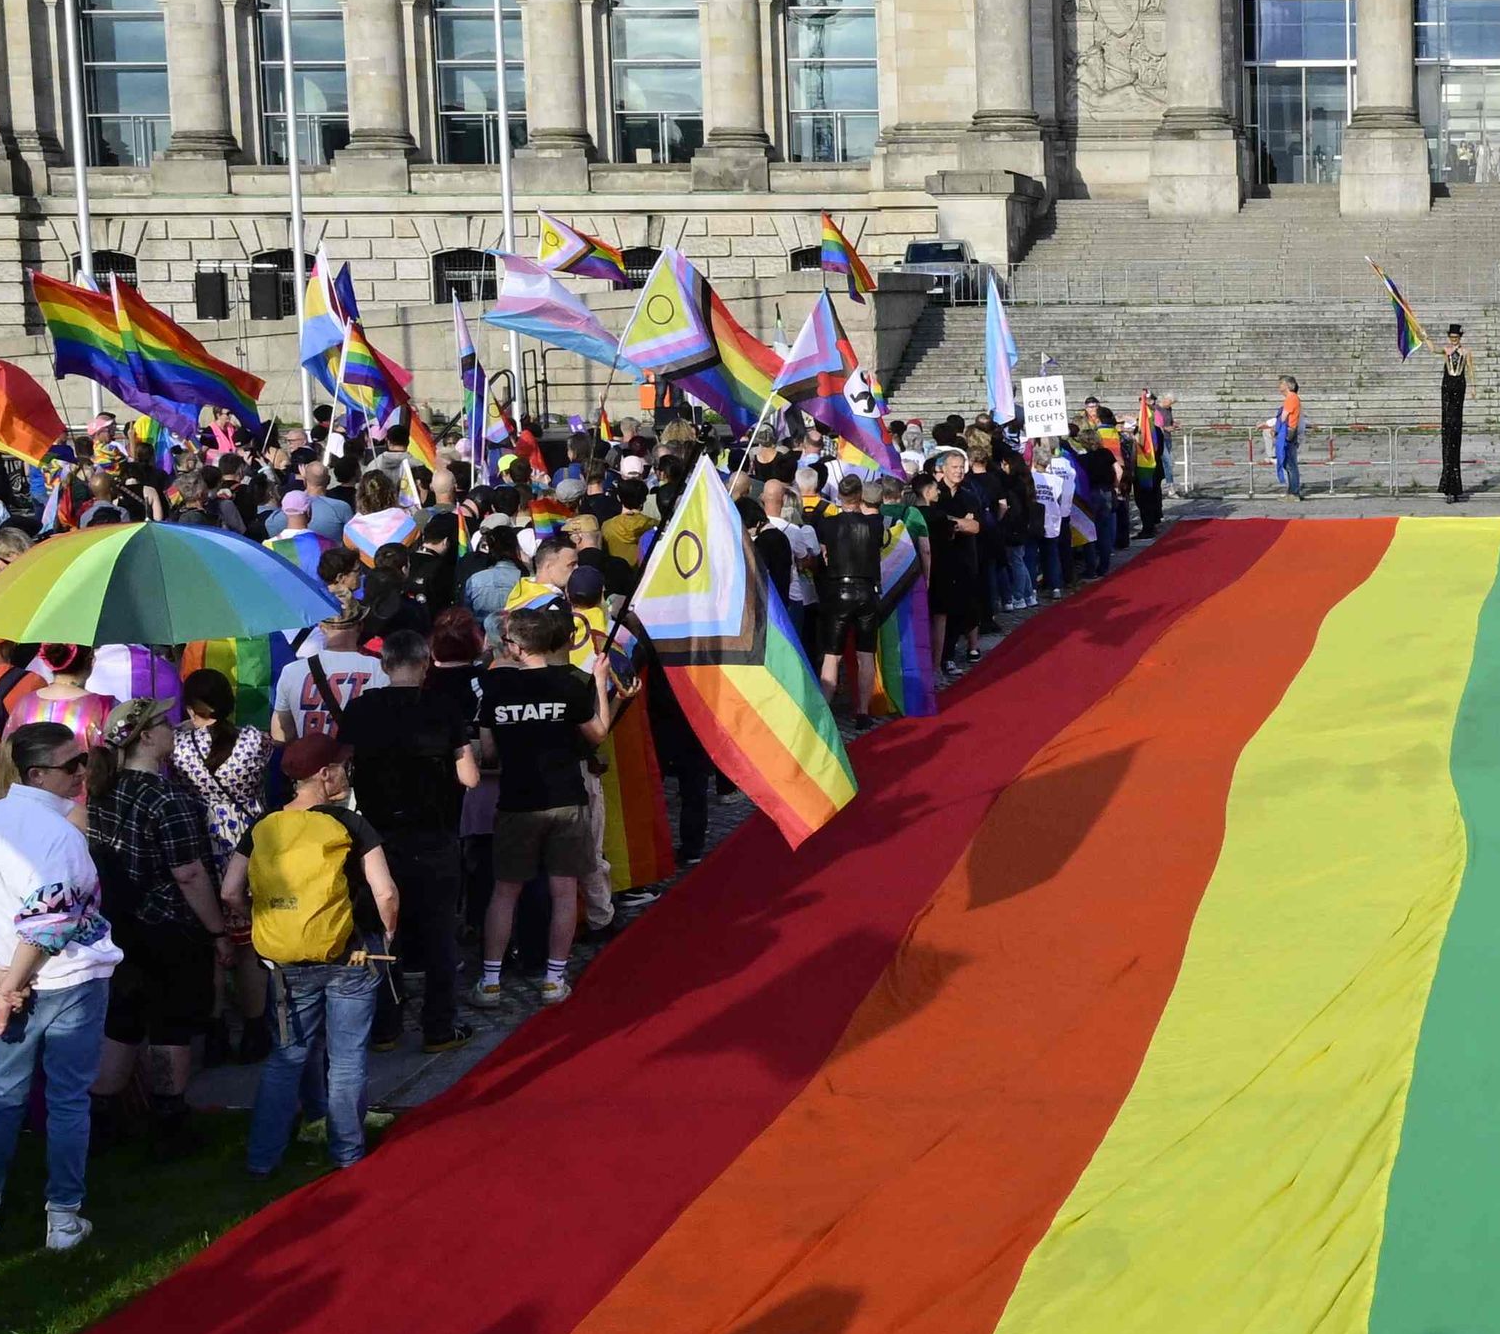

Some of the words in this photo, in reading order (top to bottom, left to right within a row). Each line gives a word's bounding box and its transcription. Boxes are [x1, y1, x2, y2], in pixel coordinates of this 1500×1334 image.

[1028, 384, 1058, 395] OMAS
[1028, 398, 1062, 408] GEGEN
[1027, 413, 1065, 423] RECHTS
[494, 702, 567, 723] STAFF
